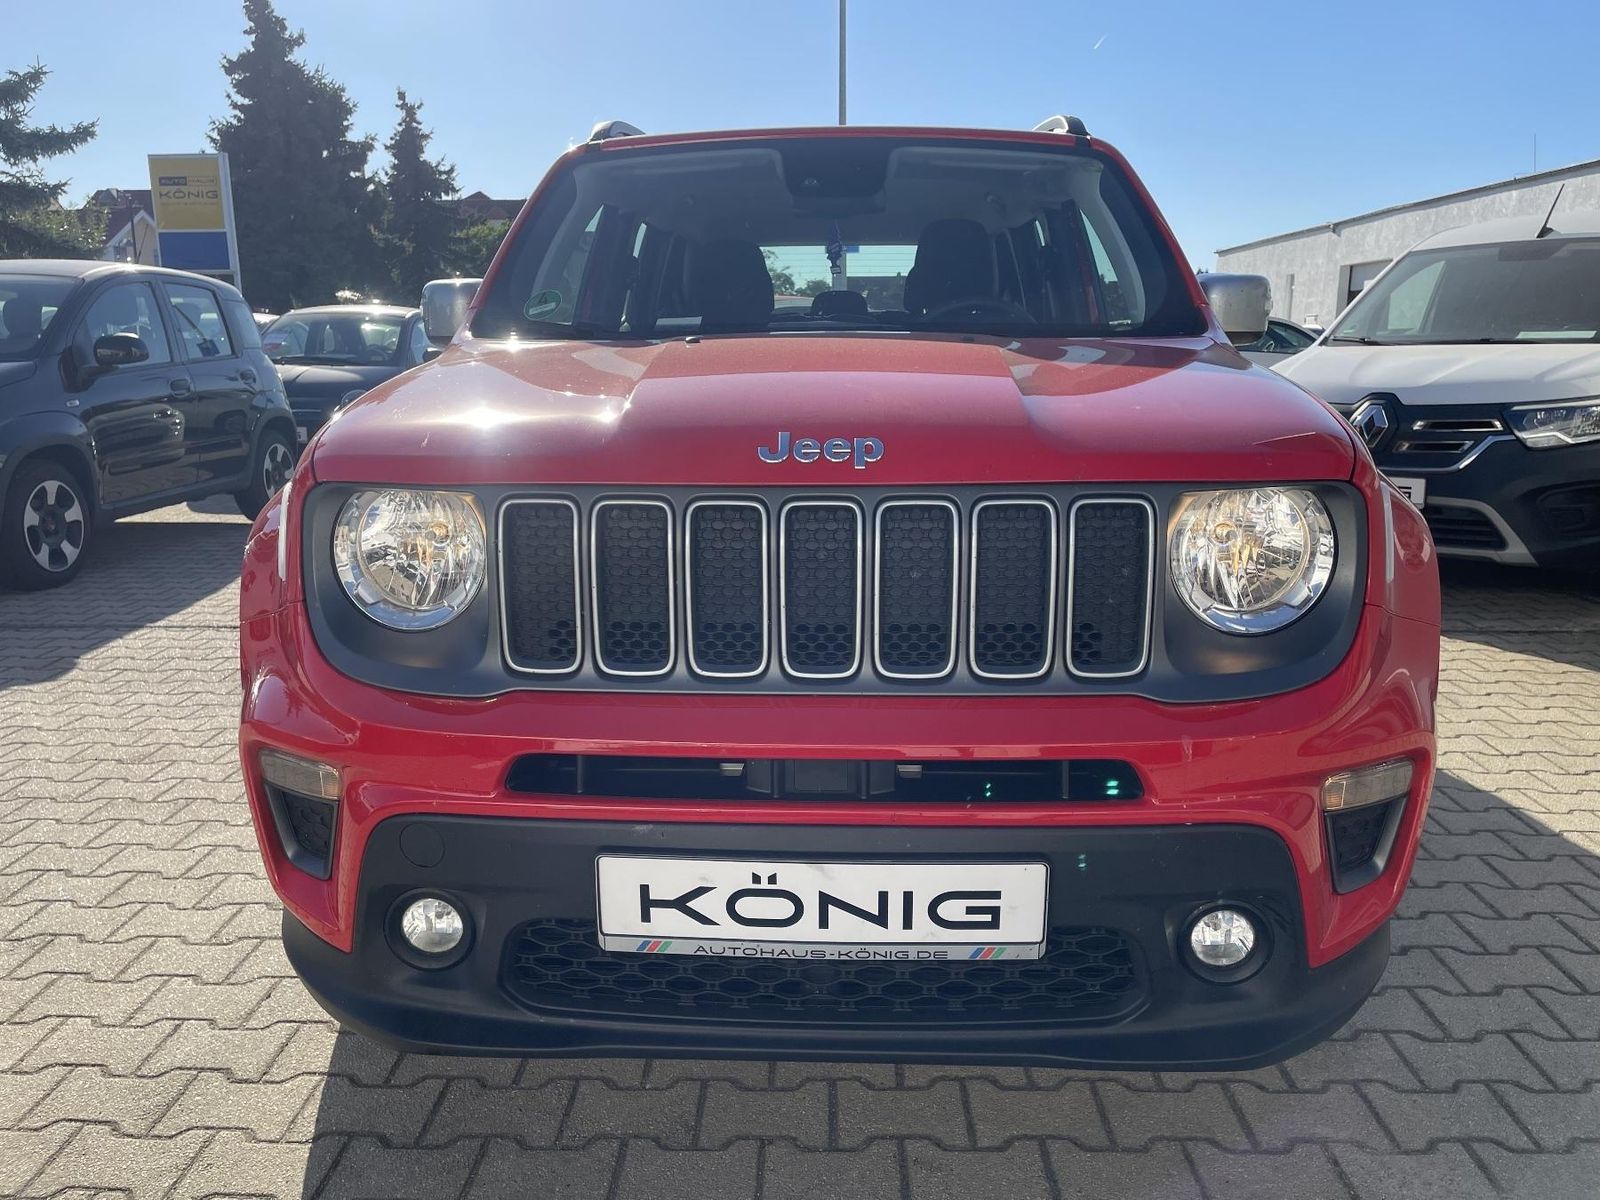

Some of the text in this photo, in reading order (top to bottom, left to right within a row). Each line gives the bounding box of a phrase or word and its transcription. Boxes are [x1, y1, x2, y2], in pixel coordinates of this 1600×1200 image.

[159, 188, 219, 200] KÖNIG
[757, 431, 885, 469] Jeep
[640, 871, 1002, 931] KÖNIG
[693, 945, 949, 960] AUTOHAUS-KÖNIG.DE
